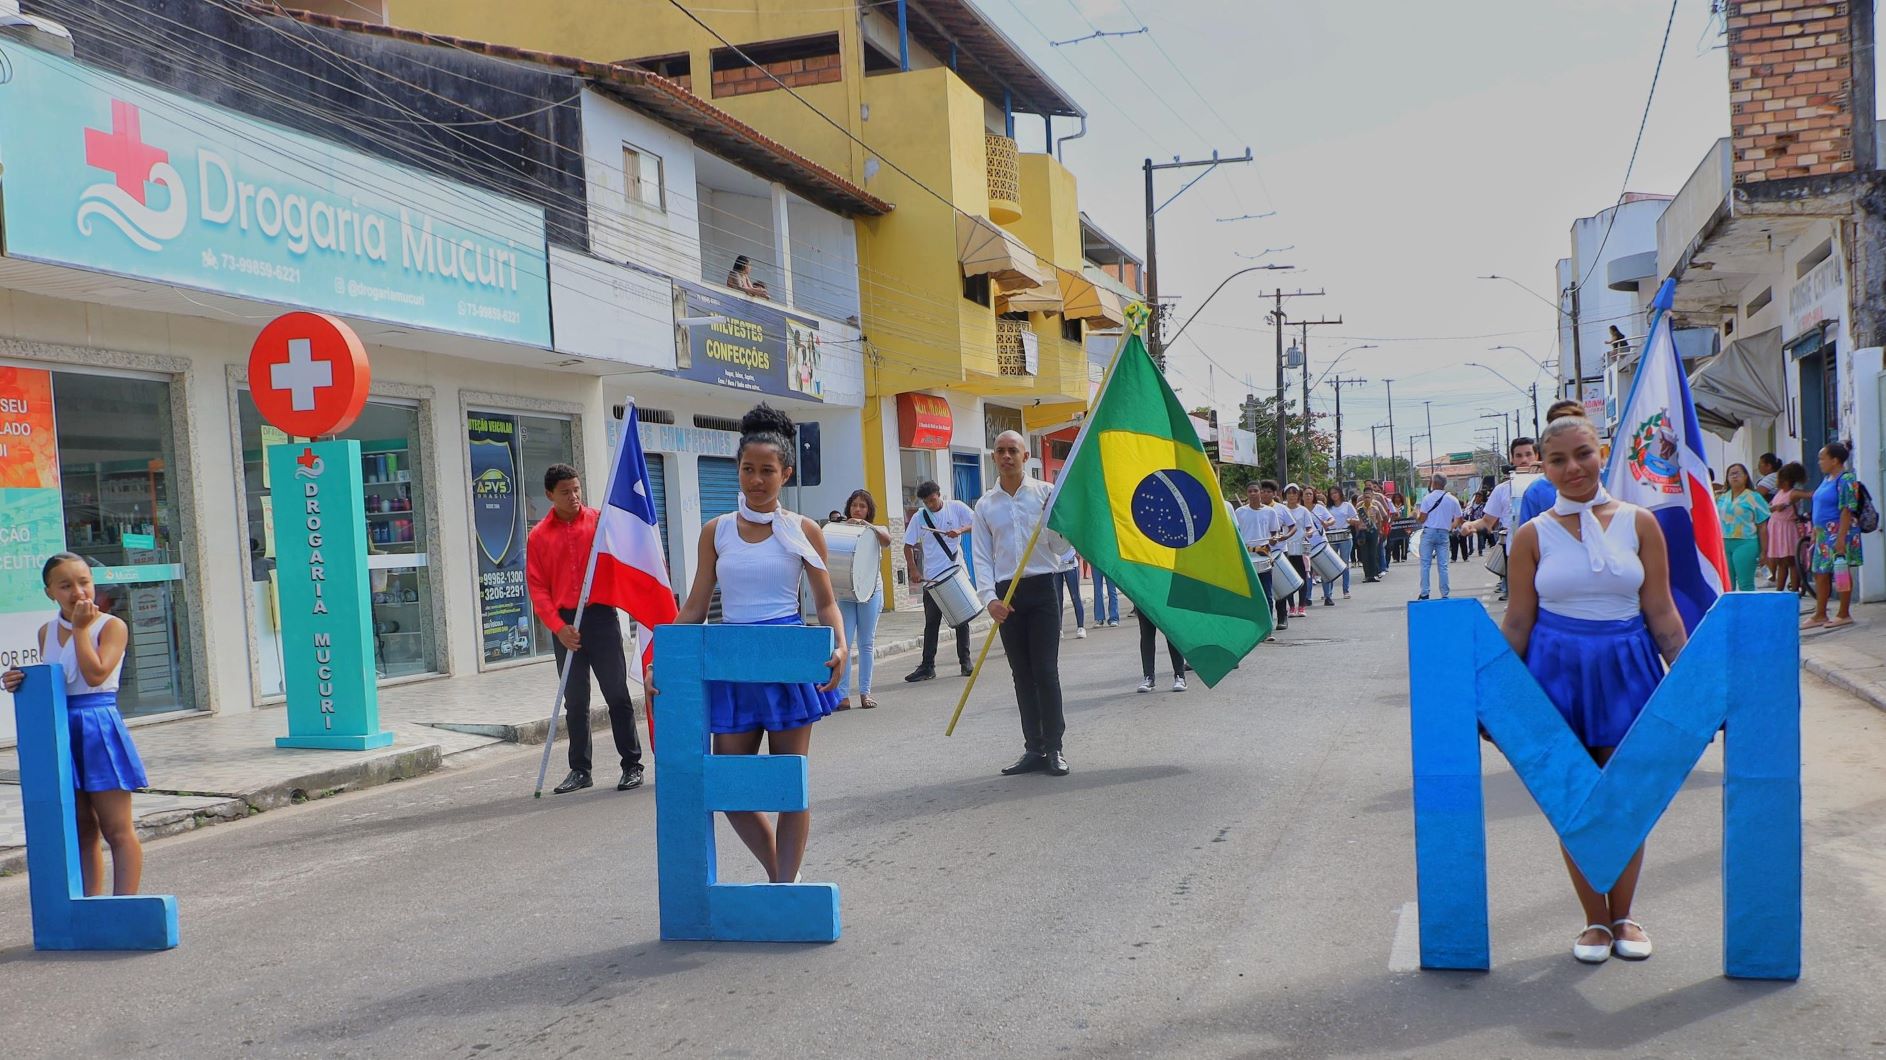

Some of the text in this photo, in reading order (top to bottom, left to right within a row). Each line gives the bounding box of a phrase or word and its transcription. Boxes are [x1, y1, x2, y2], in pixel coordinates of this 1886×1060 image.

[198, 148, 518, 291] Drogaria Mucuri
[706, 339, 770, 371] CONFECÇÕES
[0, 398, 29, 414] SEU
[477, 481, 507, 494] APVS
[483, 570, 524, 586] 99962-1300
[484, 585, 525, 601] 3206-2291
[304, 482, 336, 731] DROGARIA MUCURI
[653, 624, 841, 942] E
[1407, 591, 1802, 980] M
